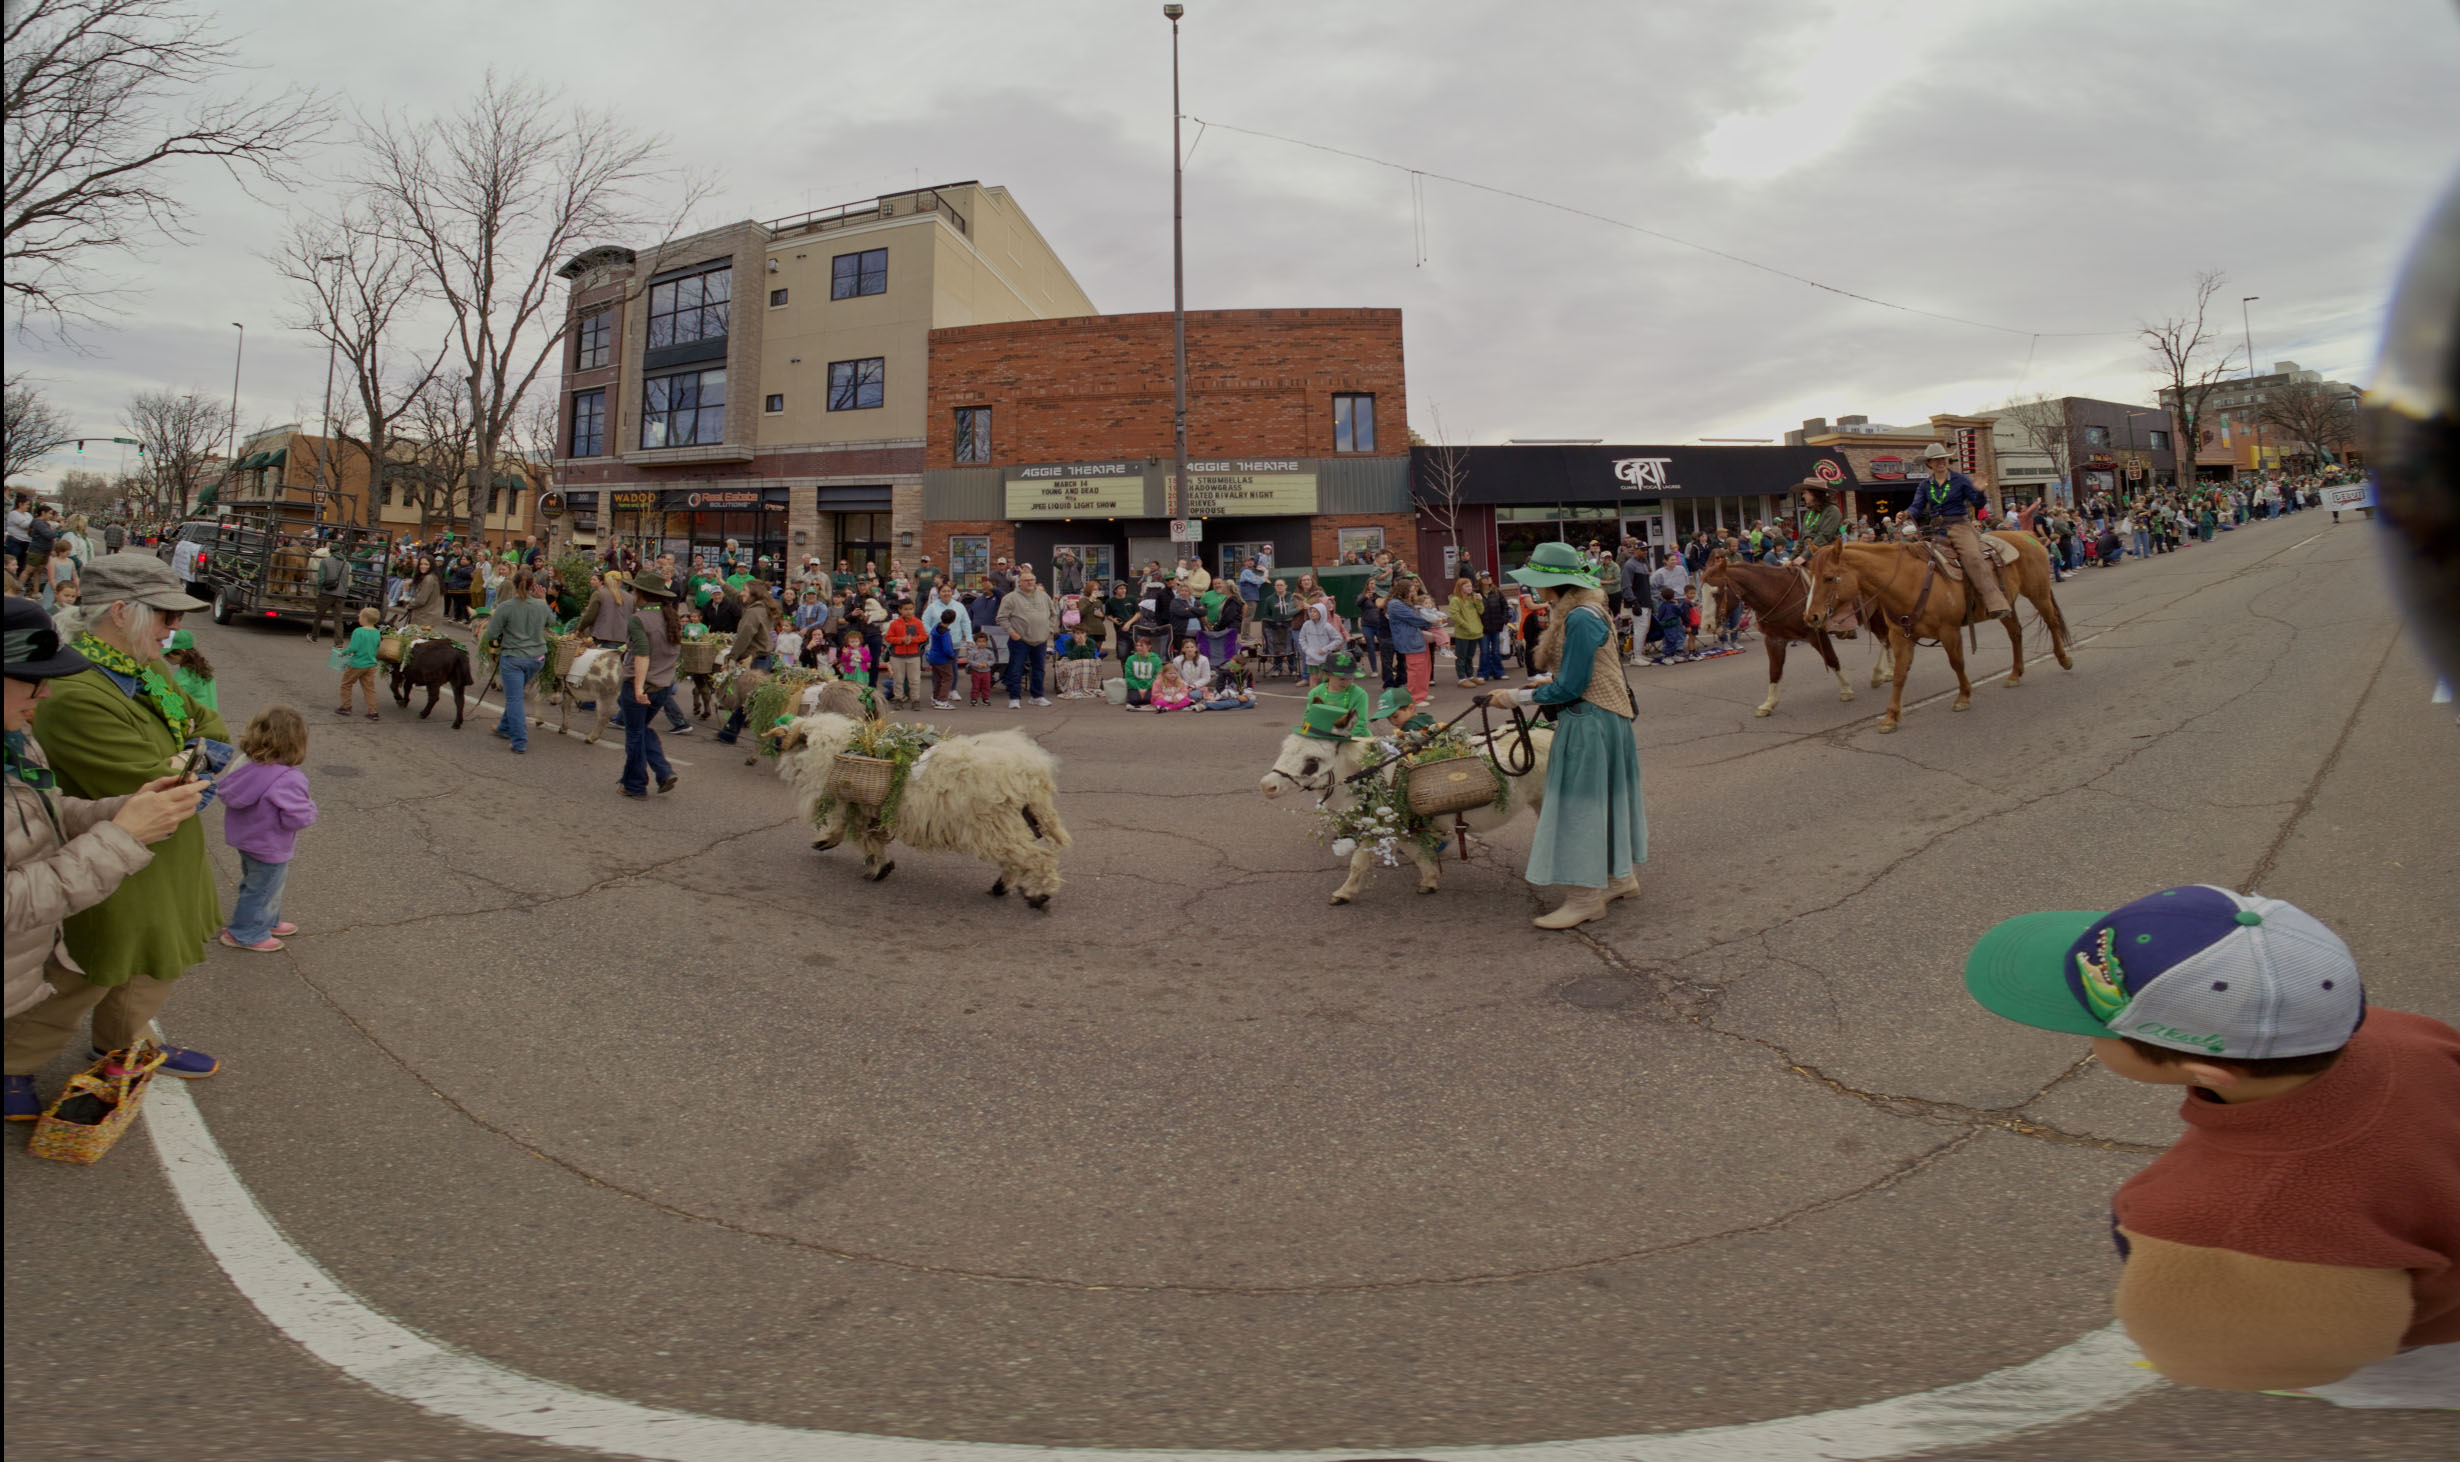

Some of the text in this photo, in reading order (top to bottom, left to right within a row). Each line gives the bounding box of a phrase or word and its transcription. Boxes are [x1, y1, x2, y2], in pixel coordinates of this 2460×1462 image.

[1021, 464, 1126, 478] AGGIE THEATRE
[1186, 461, 1299, 472] AGGIE THEATRE
[1197, 476, 1254, 484] STRUMBELLAS
[1041, 486, 1099, 496] YOUNG AND DEAD
[1214, 491, 1248, 499] RIVALRY
[1249, 491, 1275, 499] NIGHT
[614, 492, 657, 503] WADOO
[1047, 502, 1072, 510] LIQUID
[1073, 501, 1094, 509] LIGHT
[1096, 500, 1117, 508] SHOW
[1188, 506, 1226, 514] OPHOUSE
